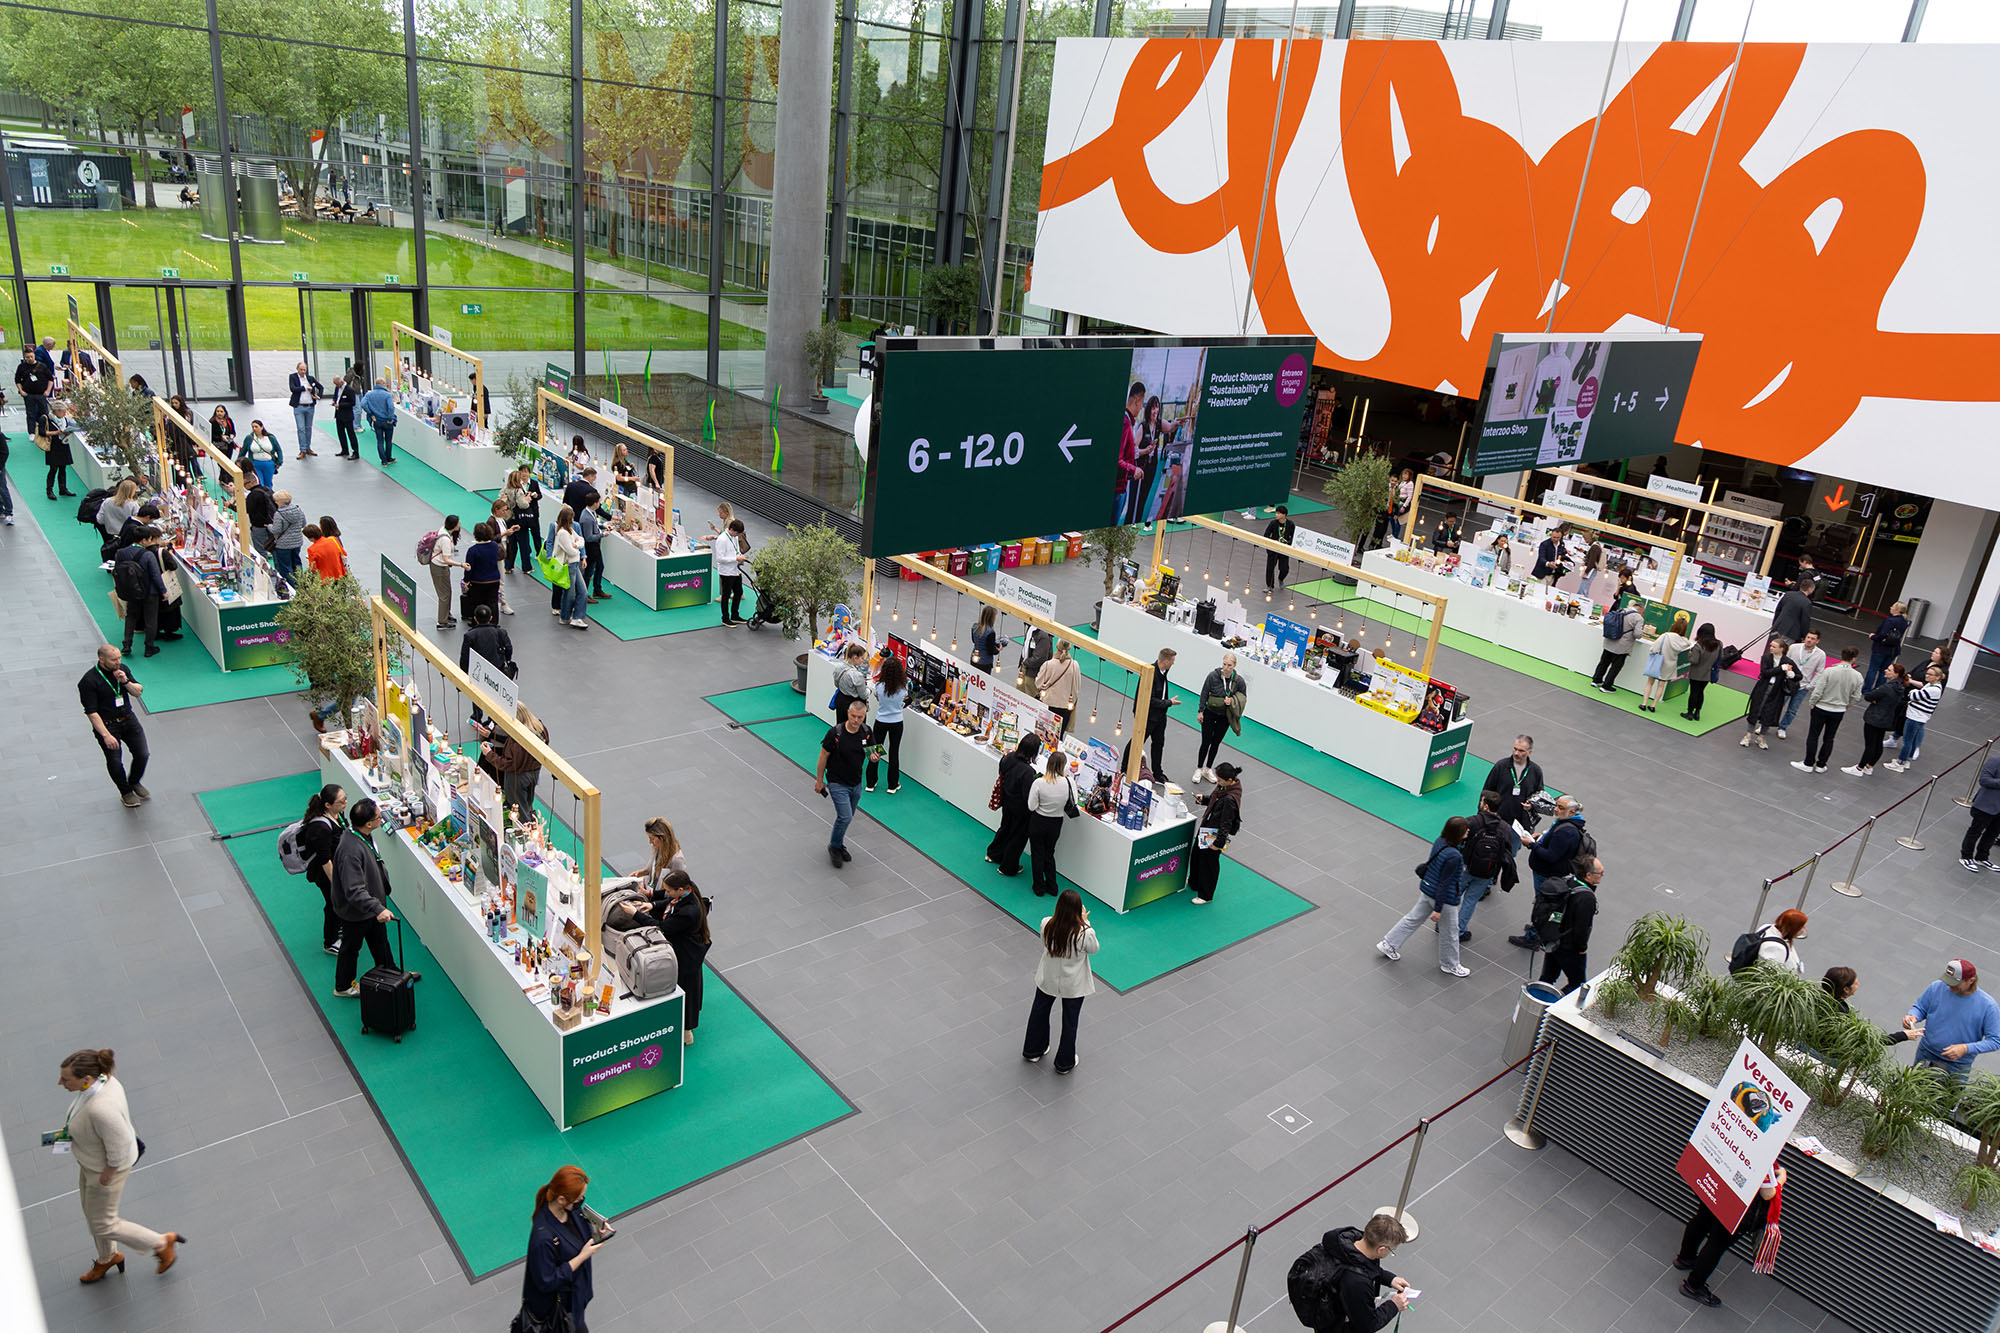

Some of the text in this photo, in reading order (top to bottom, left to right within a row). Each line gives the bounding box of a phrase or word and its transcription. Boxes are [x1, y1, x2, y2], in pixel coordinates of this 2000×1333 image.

[1211, 372, 1273, 383] Product Showcase
[1281, 379, 1300, 387] Eingang
[1209, 384, 1268, 395] “Sustainability” &
[1208, 396, 1252, 407] “Healthcare”
[1483, 425, 1528, 437] Interzoo Shop
[908, 438, 929, 473] 6
[961, 431, 1024, 469] 12.0
[1666, 484, 1698, 496] Healthcare
[1558, 499, 1596, 514] Sustainability
[1860, 493, 1876, 518] 1
[1315, 545, 1347, 560] Produktmix
[1316, 538, 1350, 554] Productmix
[661, 568, 708, 578] Product Showcase
[1018, 586, 1052, 607] Productmix
[1018, 594, 1050, 613] Produktmix
[227, 620, 280, 632] Product Show
[240, 636, 269, 645] Highlight
[484, 673, 513, 706] Hund Dog
[1431, 740, 1466, 757] Product Showcase
[1134, 842, 1188, 866] Product Showcase
[1140, 866, 1163, 879] Highlight
[573, 1024, 674, 1066] Product Showcase
[590, 1062, 632, 1082] Highlight
[1744, 1053, 1793, 1112] Versele
[1716, 1112, 1731, 1131] You
[1721, 1101, 1758, 1141] Excited?
[1711, 1122, 1739, 1154] should
[1738, 1150, 1752, 1169] be.
[1702, 1178, 1716, 1194] Care.
[1706, 1172, 1718, 1190] Feed.
[1696, 1178, 1717, 1204] Connect.
